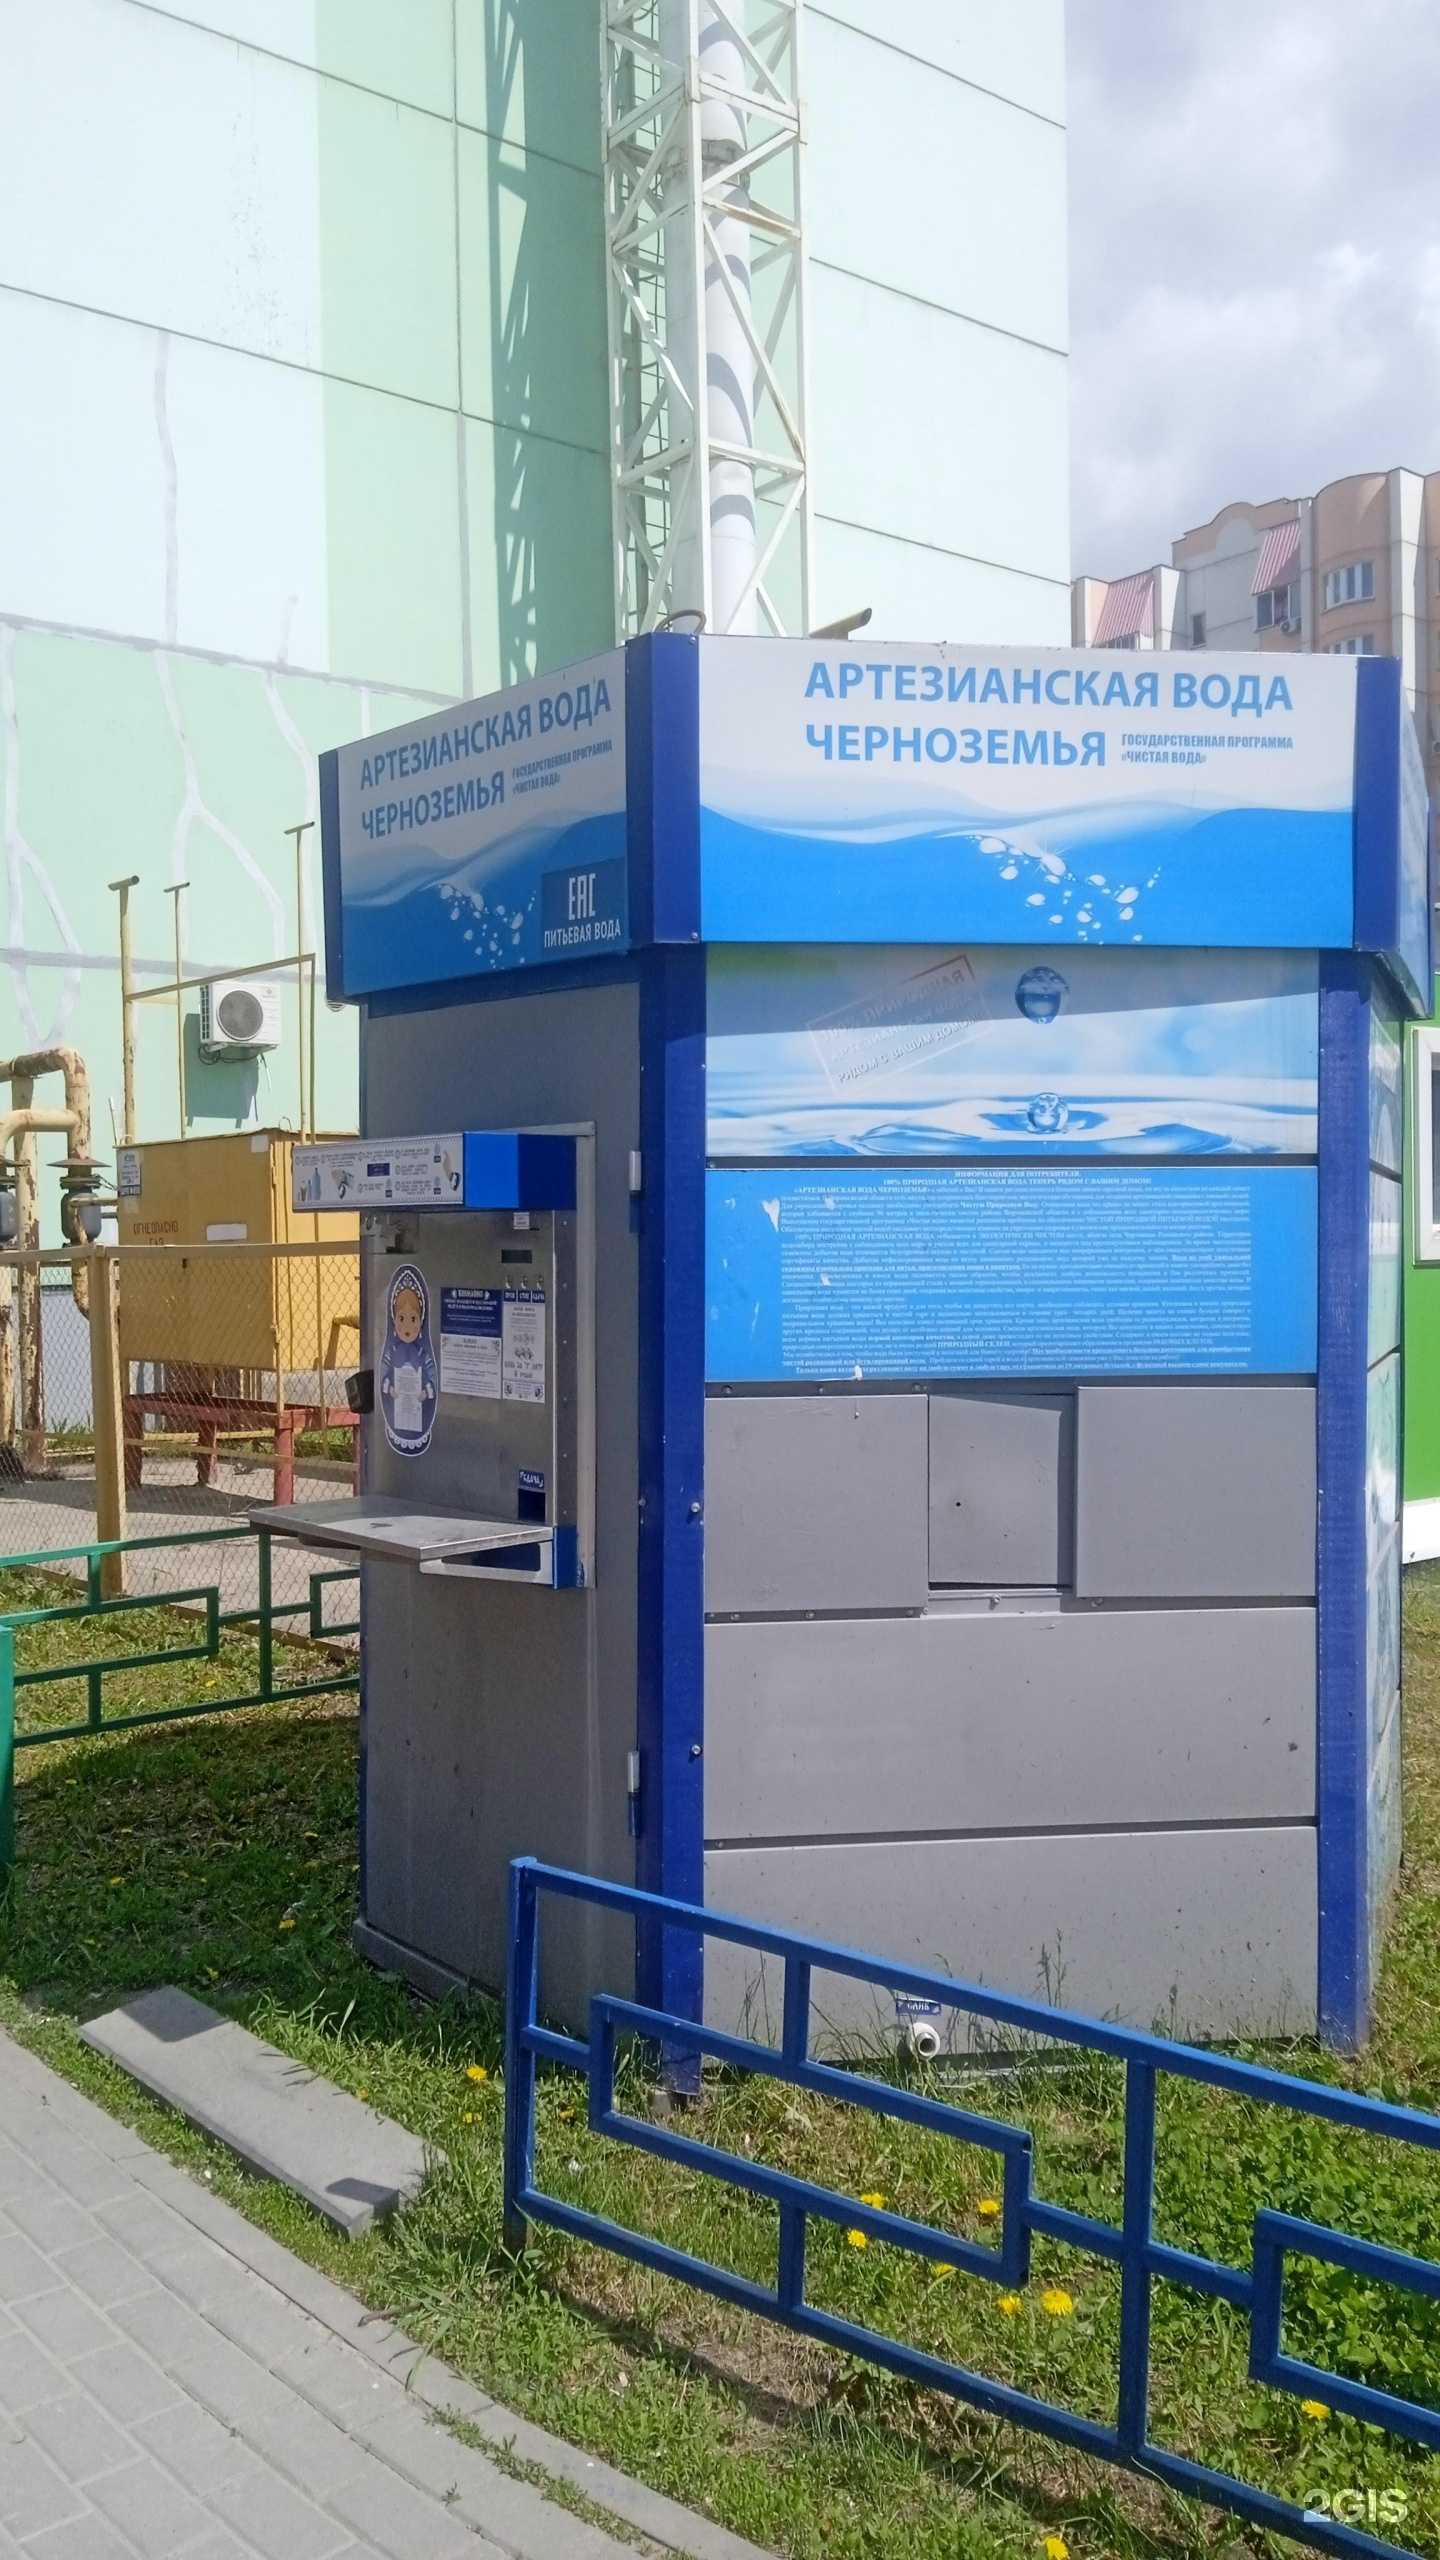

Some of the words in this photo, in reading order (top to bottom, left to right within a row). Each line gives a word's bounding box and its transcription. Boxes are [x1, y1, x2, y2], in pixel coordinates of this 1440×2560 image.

[804, 662, 1159, 708] АРТЕЗИАНСКАЯ
[1172, 673, 1294, 717] ВОДА
[361, 704, 532, 790] АРТЕЗИАНСКАЯ
[539, 679, 612, 732] ВОДА
[805, 724, 1106, 767] ЧЕРНОЗЕМЬЯ
[1121, 733, 1226, 749] ГОСУДАРСТВЕННАЯ
[1227, 735, 1294, 750] ПРОГРАММА
[361, 770, 505, 840] ЧЕРНОЗЕМЬЯ
[544, 923, 592, 948] ПИТЬЕВАЯ
[593, 918, 621, 940] ВОДА
